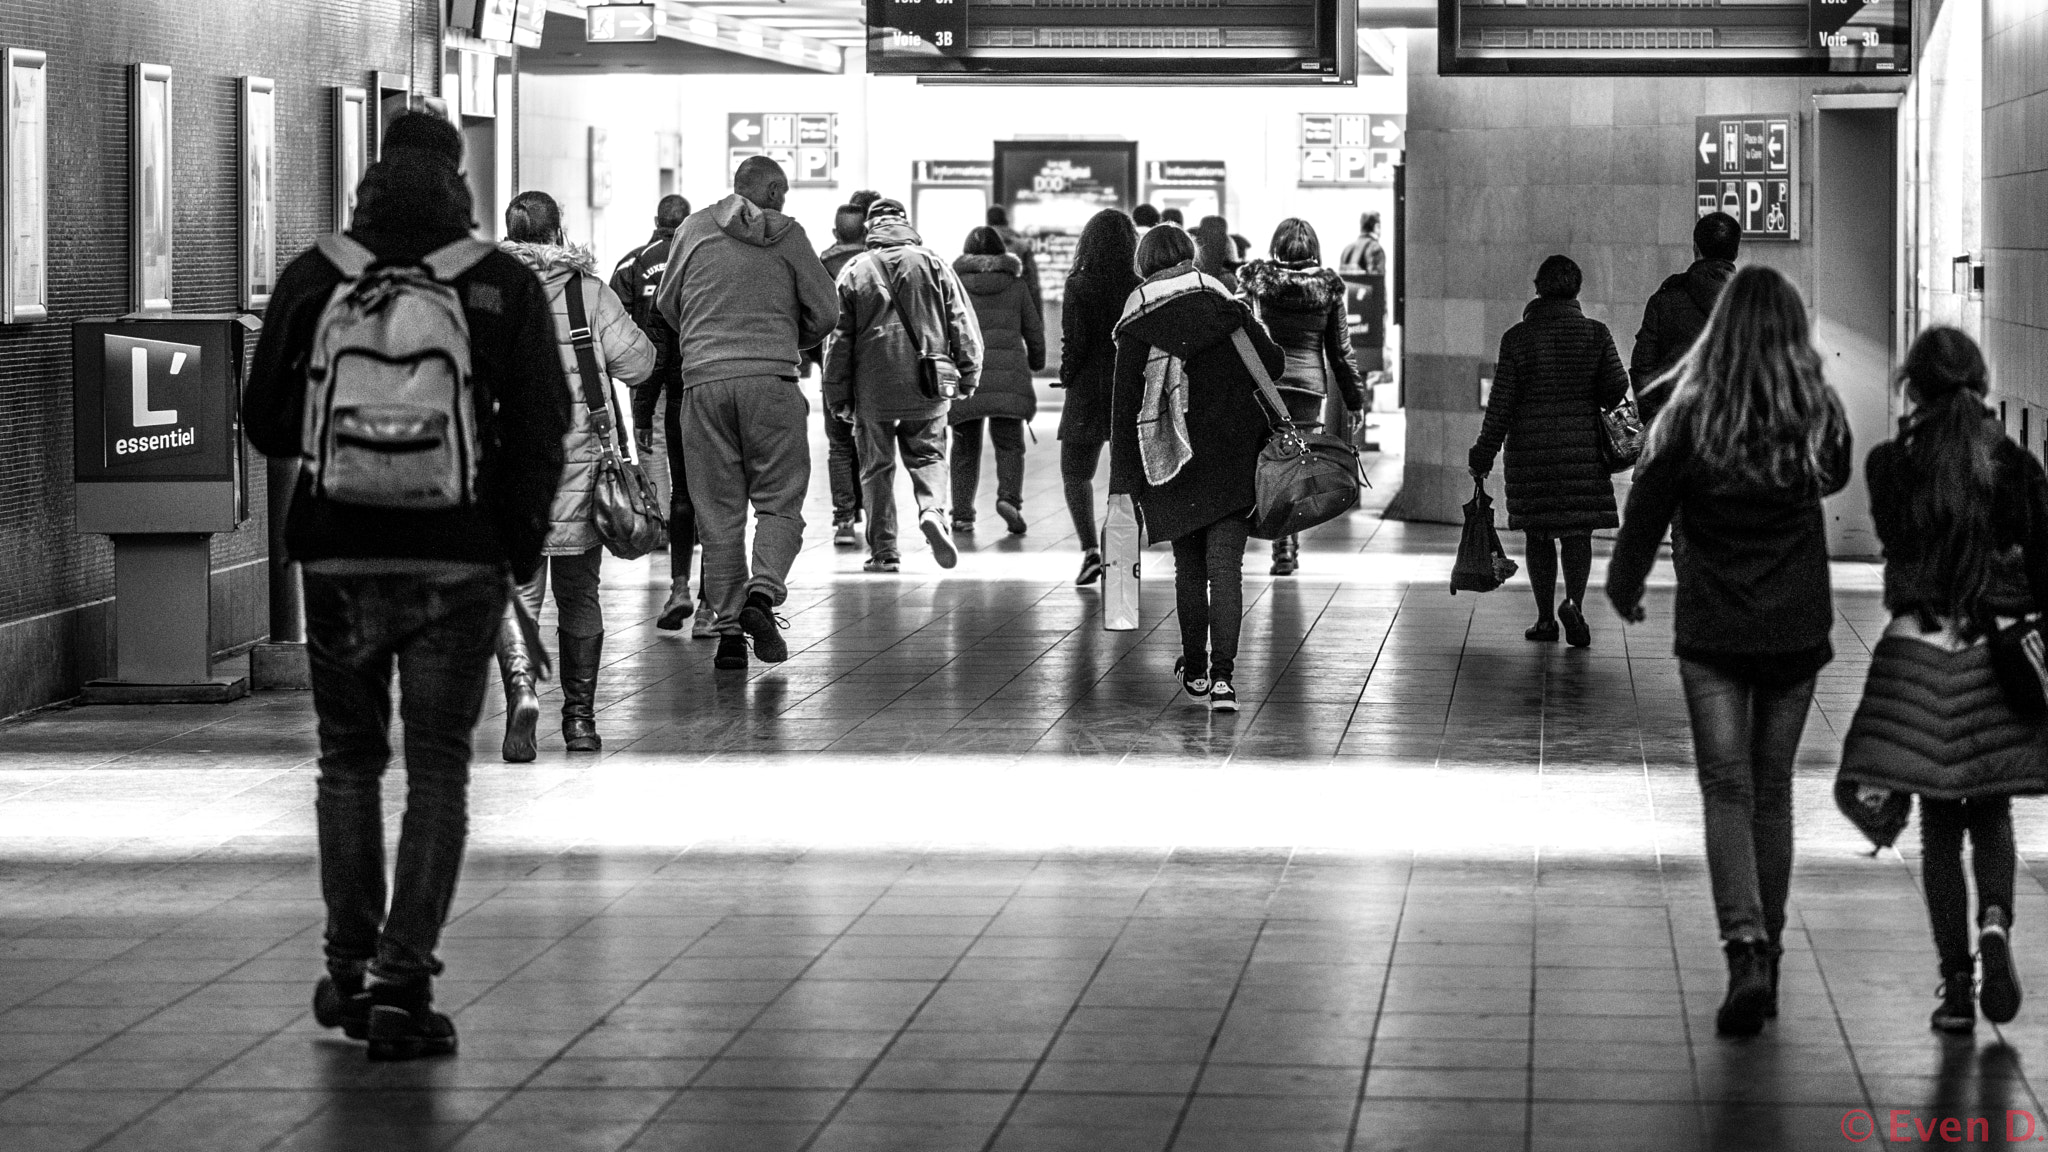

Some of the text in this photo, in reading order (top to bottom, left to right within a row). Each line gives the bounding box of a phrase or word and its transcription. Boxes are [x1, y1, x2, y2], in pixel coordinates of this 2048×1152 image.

[893, 31, 953, 46] Voie 3B
[1819, 31, 1879, 47] Voie 3D
[1746, 181, 1762, 231] P
[131, 346, 187, 428] L'
[115, 426, 194, 455] essentiel
